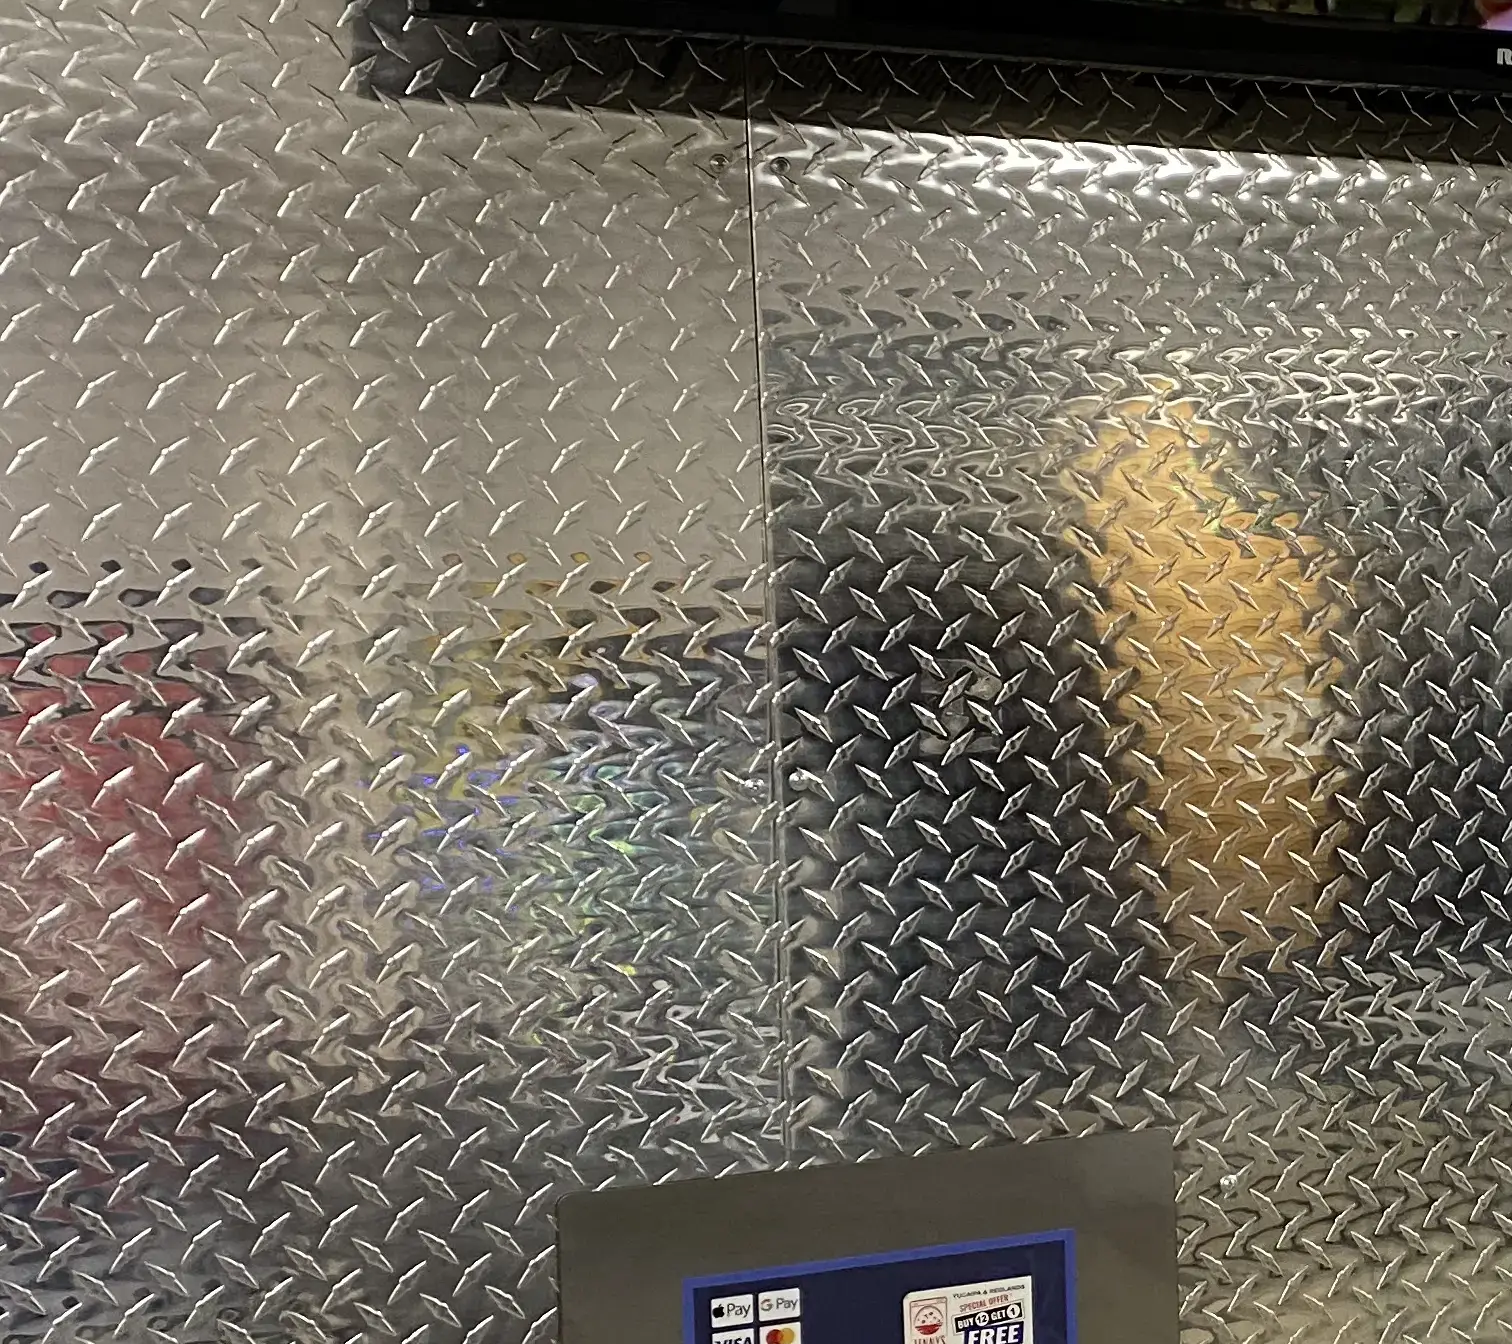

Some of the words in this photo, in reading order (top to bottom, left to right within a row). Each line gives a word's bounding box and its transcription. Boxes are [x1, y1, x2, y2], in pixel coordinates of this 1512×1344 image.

[726, 1303, 751, 1318] Pay
[776, 1297, 798, 1311] Pay
[959, 1300, 987, 1312] SPECIAL
[988, 1294, 1009, 1305] OFFER
[957, 1317, 974, 1329] BUY
[976, 1313, 987, 1324] 12
[990, 1309, 1006, 1320] GET
